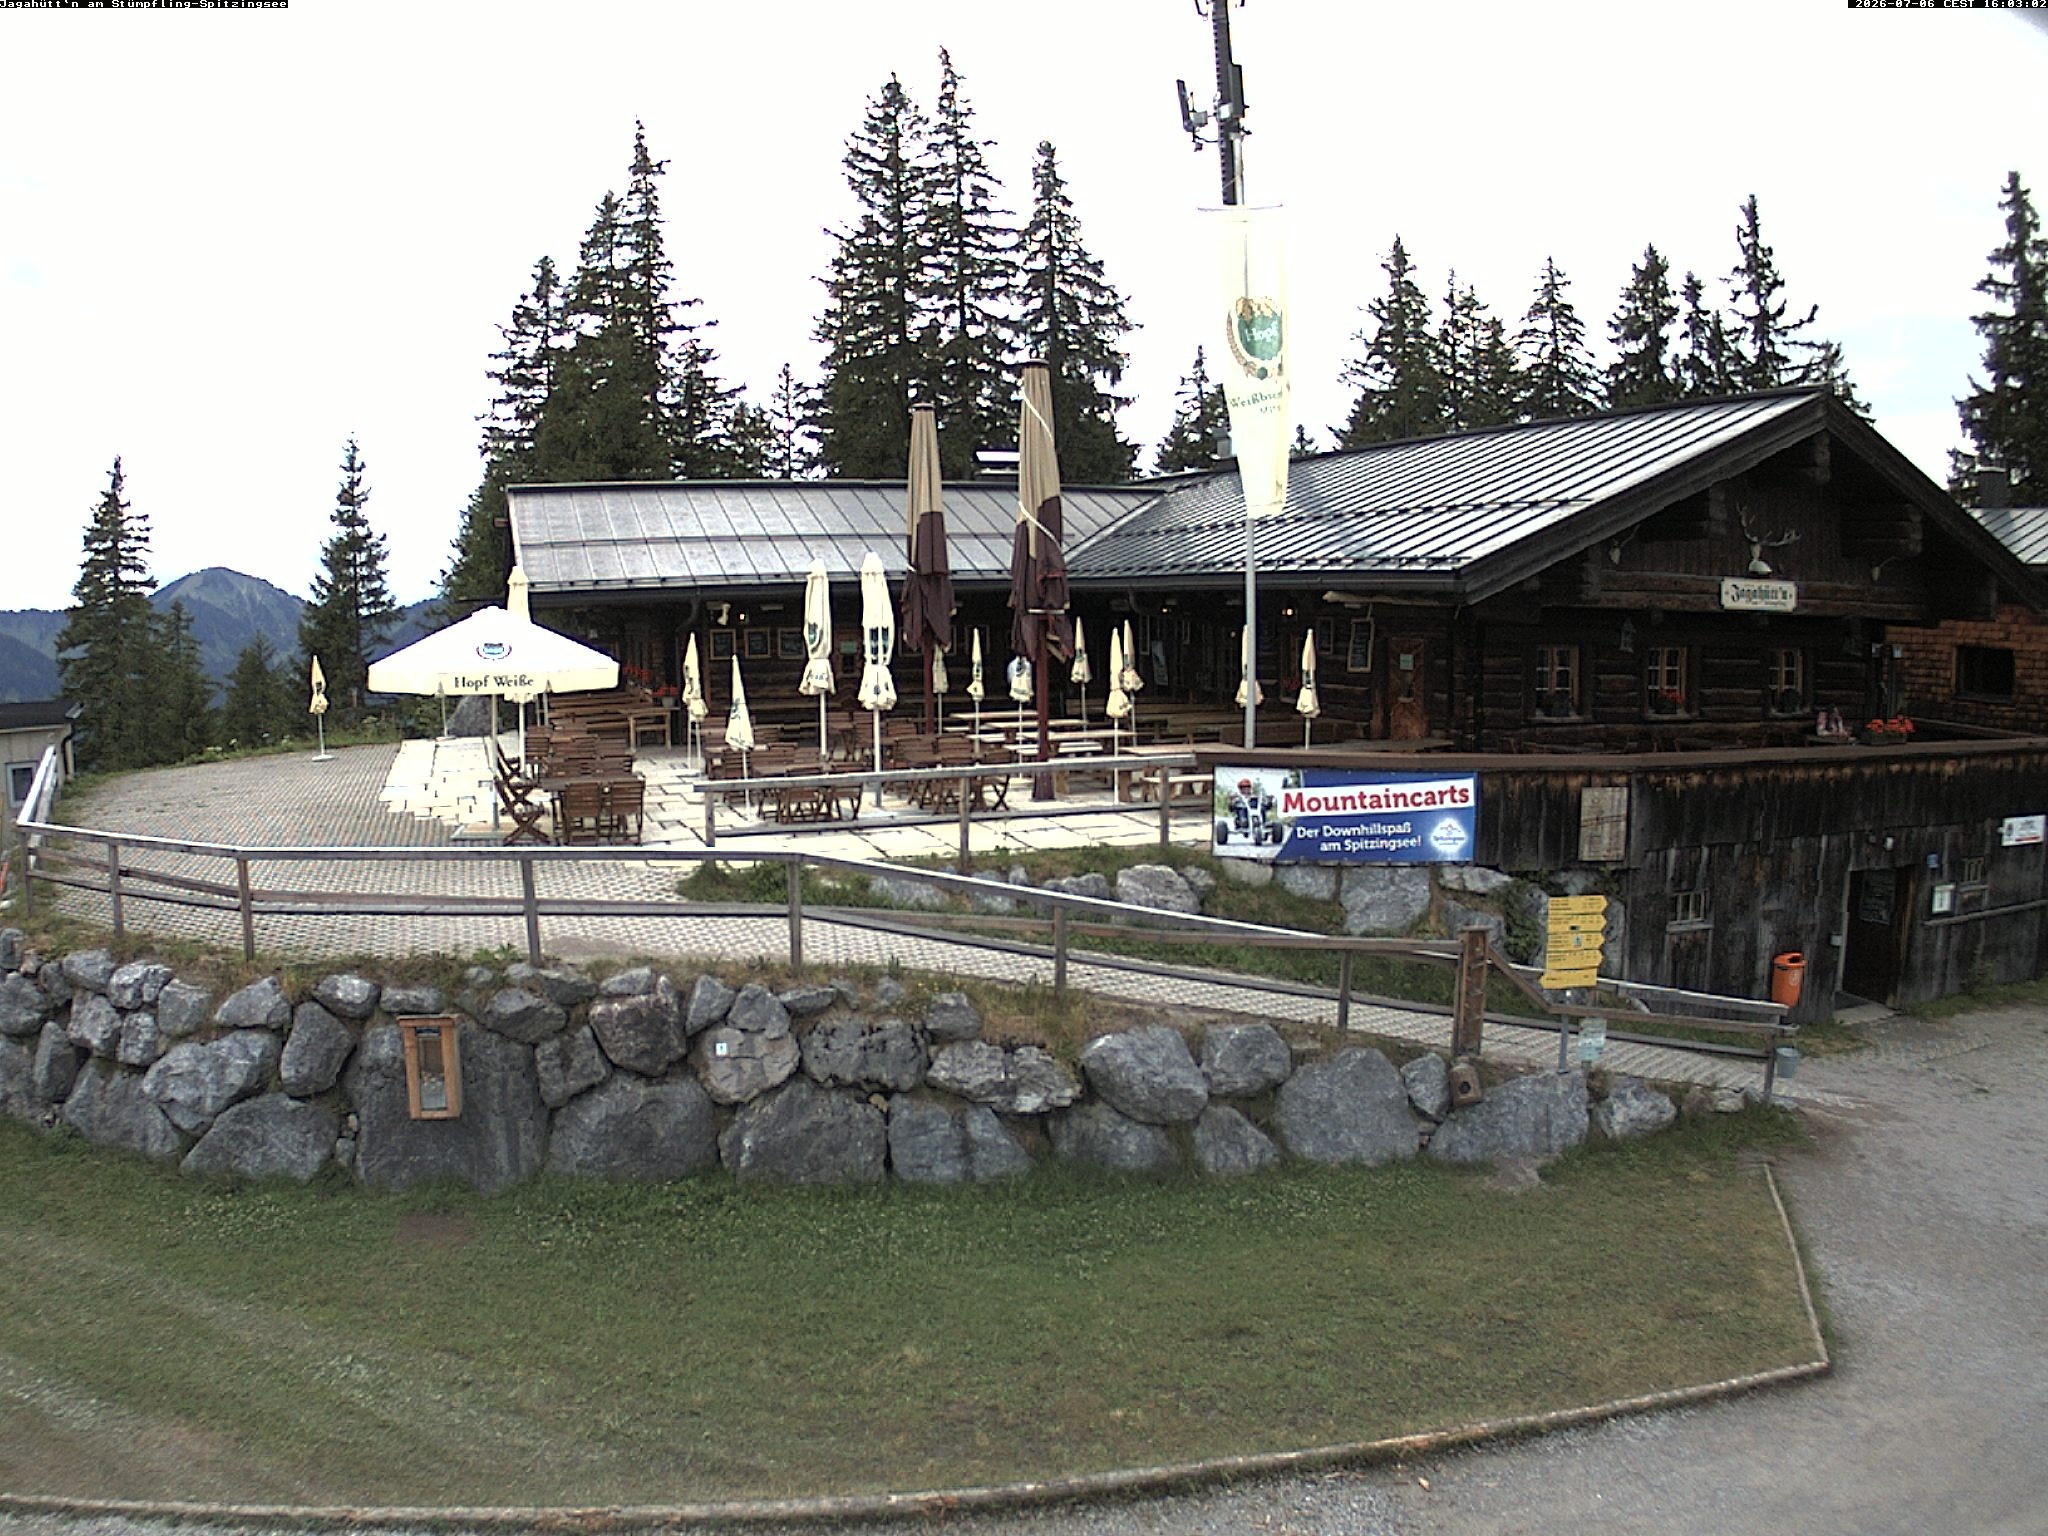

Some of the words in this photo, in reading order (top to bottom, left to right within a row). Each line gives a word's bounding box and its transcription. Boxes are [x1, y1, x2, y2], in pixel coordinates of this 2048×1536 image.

[454, 674, 490, 692] Hopf
[493, 673, 534, 688] Weiße
[1282, 785, 1470, 814] Mountaincarts
[1296, 826, 1319, 839] Der
[1322, 821, 1411, 837] Downhillspaß
[1320, 841, 1341, 852] am
[1344, 835, 1421, 853] Spitzingsee!
